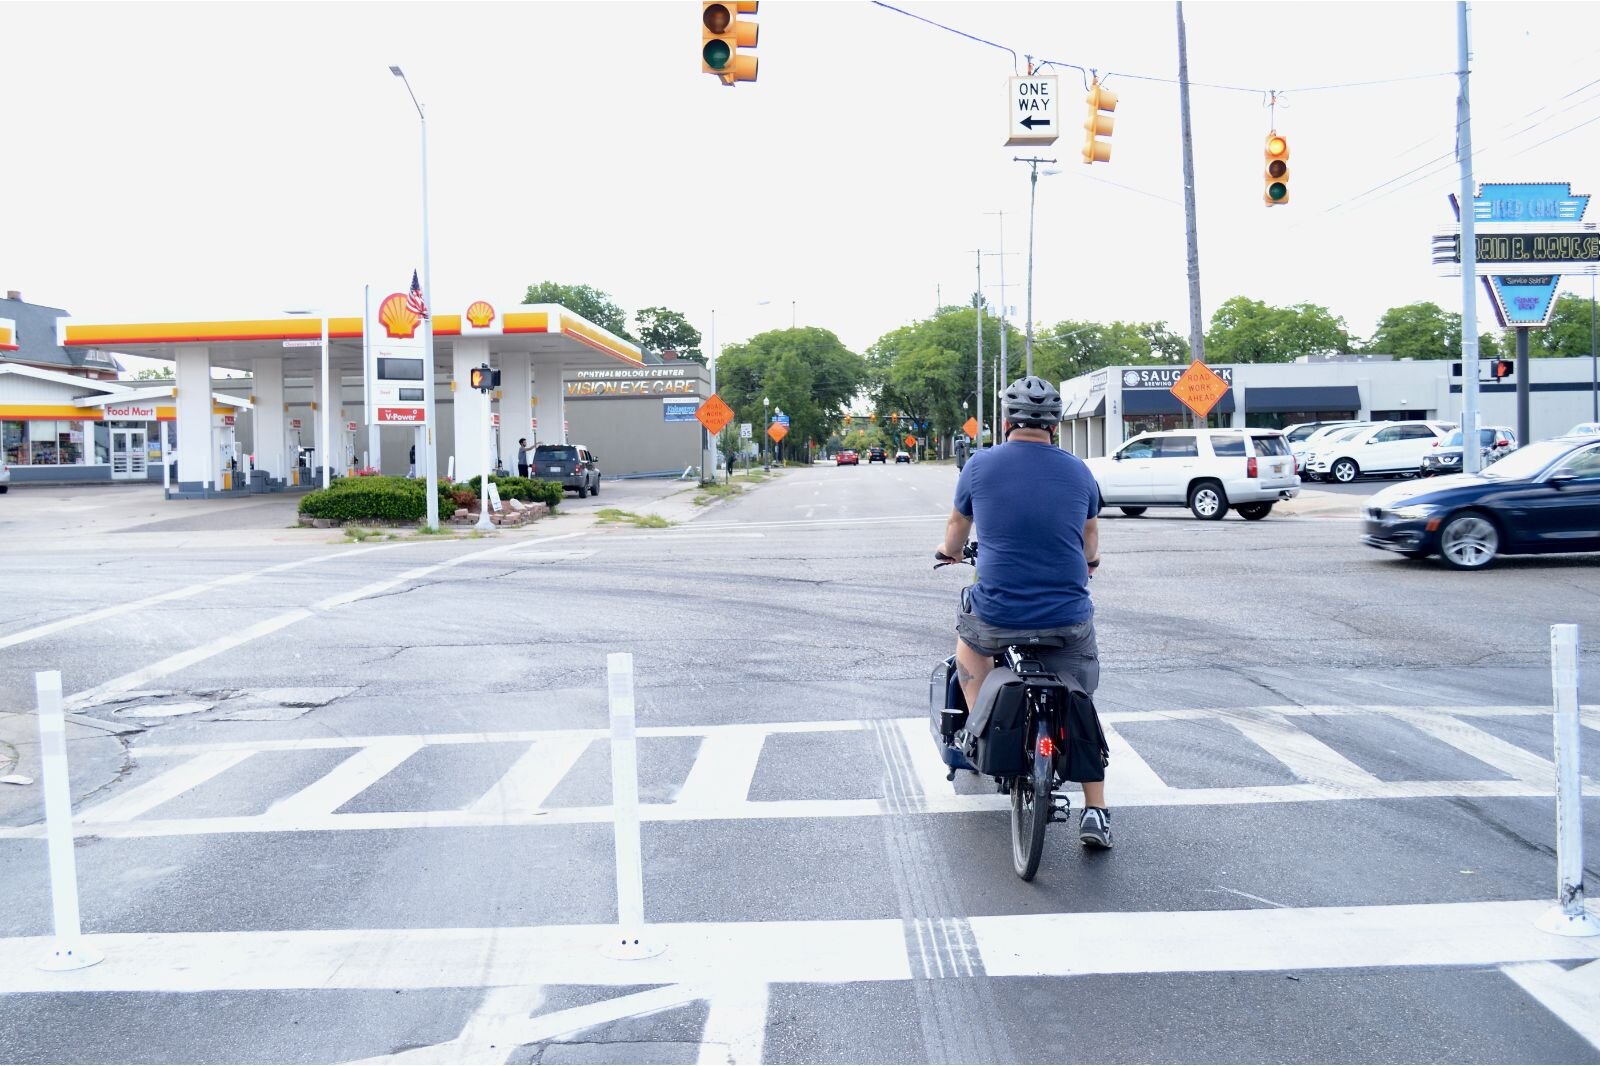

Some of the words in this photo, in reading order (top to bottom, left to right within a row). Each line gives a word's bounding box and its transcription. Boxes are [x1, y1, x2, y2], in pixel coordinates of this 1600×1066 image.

[1019, 82, 1049, 96] ONE
[1018, 98, 1050, 111] WAY
[1512, 237, 1530, 259] B.
[577, 369, 650, 378] OPHTHALMOLOGY
[651, 369, 685, 377] CENTER
[1141, 370, 1232, 381] SAUGCK
[1187, 373, 1210, 381] ROAD
[567, 381, 618, 395] VISION
[620, 380, 650, 394] EYE
[652, 380, 696, 395] CARE
[1188, 383, 1211, 392] WORK
[1187, 393, 1216, 402] AHEAD
[107, 406, 130, 416] Food
[131, 407, 153, 416] Mart
[385, 413, 416, 421] V-Power
